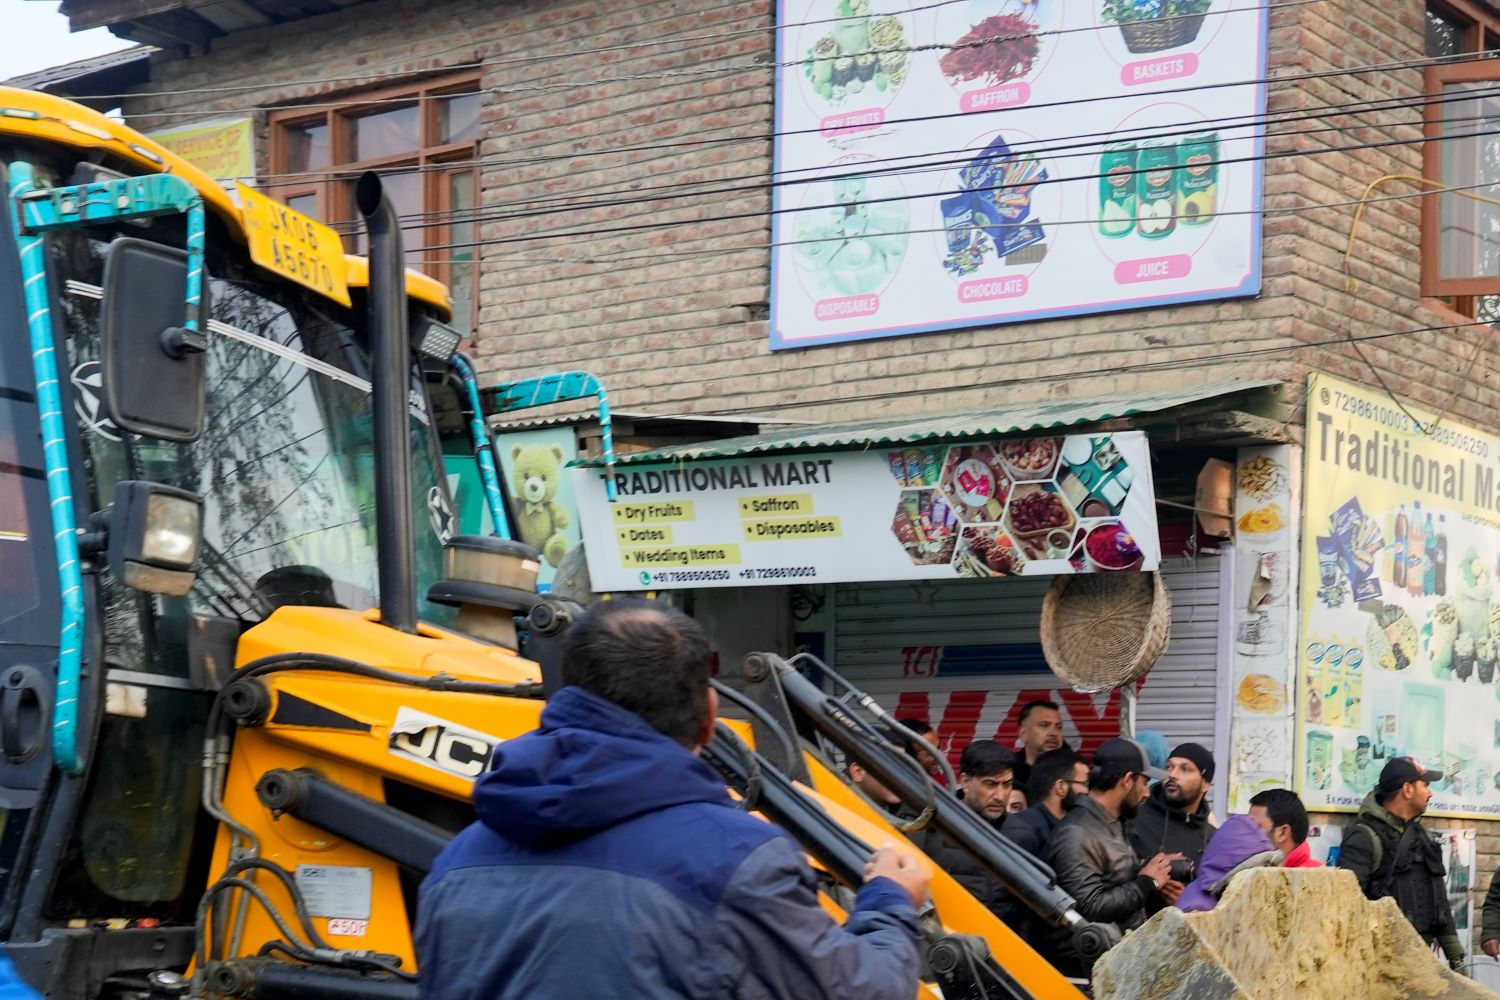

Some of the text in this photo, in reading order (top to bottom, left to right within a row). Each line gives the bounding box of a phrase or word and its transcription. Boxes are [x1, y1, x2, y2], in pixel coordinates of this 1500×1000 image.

[1133, 59, 1184, 80] BASKETS
[970, 86, 1019, 108] SAFFRON
[1136, 261, 1169, 278] JUICE
[963, 279, 1024, 299] CHOCOLATE
[818, 298, 876, 317] DISPOSABLE
[1317, 412, 1464, 502] Traditional
[762, 459, 833, 486] MART
[625, 503, 683, 521] Dry Fruits
[752, 498, 799, 512] Saffron
[629, 529, 664, 542] Dates
[756, 520, 835, 539] Disposables
[634, 548, 726, 564] Wedding Items
[901, 646, 941, 678] TCI
[396, 724, 489, 777] JC
